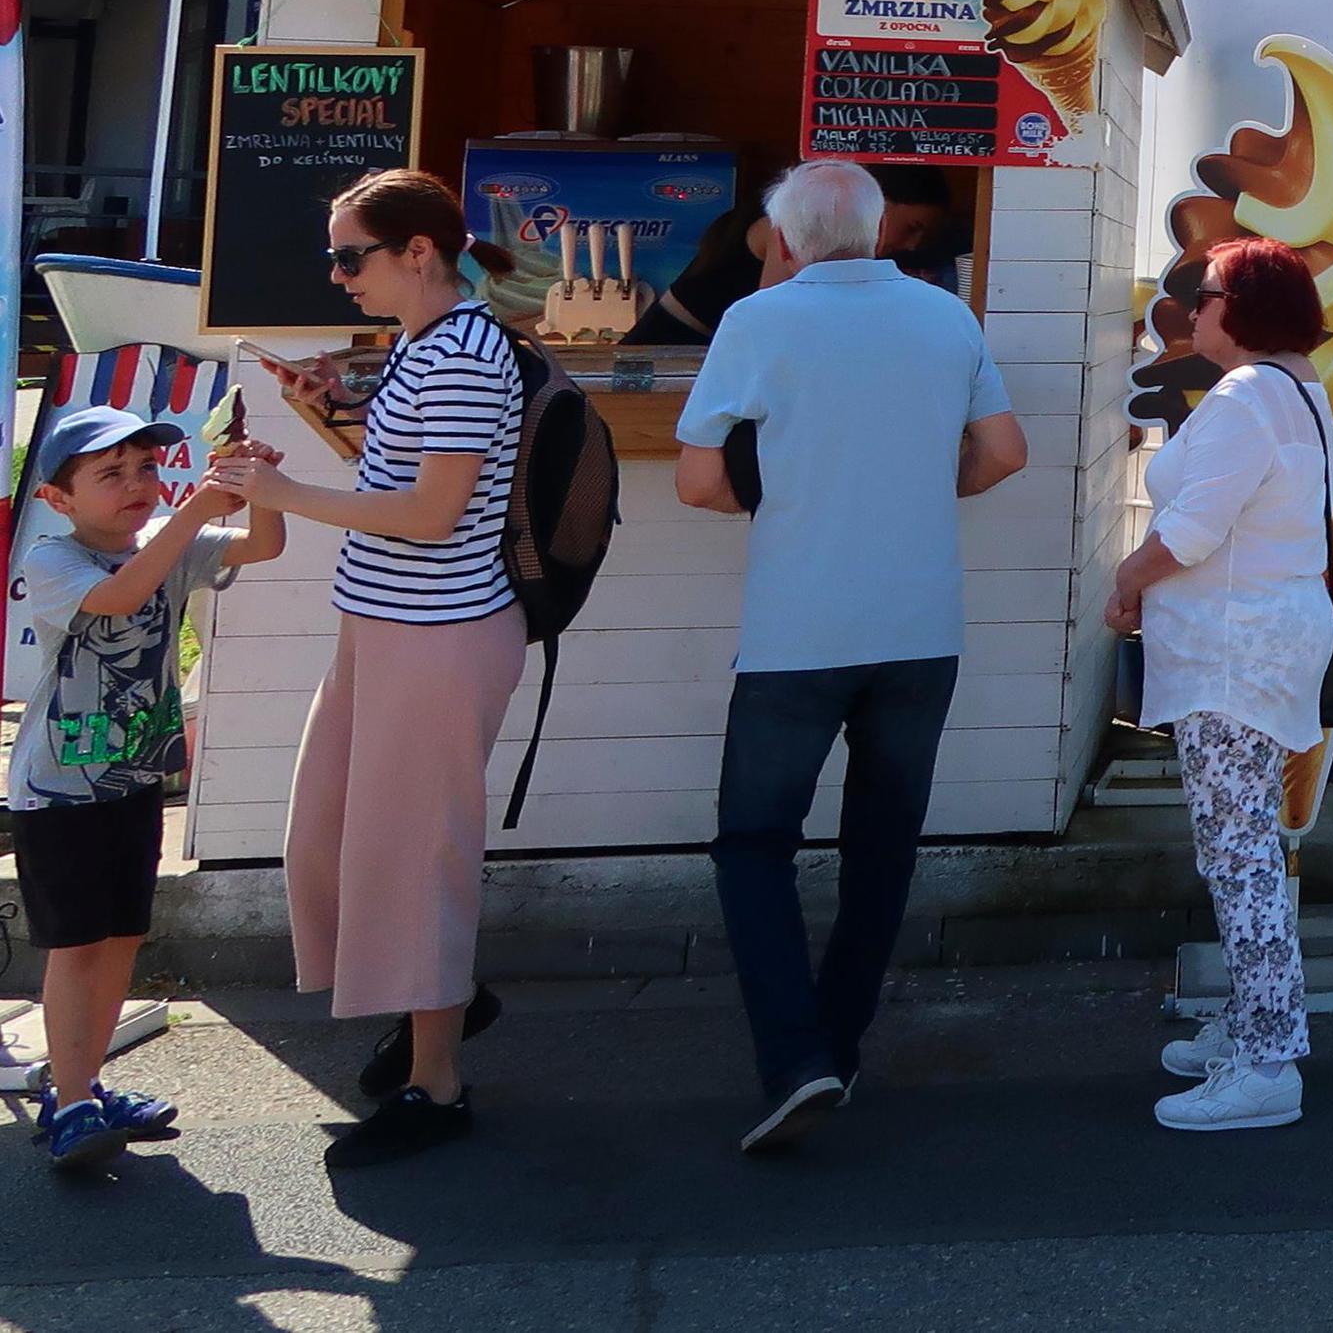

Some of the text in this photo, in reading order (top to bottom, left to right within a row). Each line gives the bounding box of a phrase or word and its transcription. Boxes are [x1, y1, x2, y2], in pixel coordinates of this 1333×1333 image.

[844, 0, 976, 21] ZMRZLINA
[879, 21, 889, 30] Z
[821, 50, 952, 77] VANILKA
[231, 60, 405, 95] LENTILKOVÝ
[819, 75, 962, 103] ČOKOLÁDA
[818, 104, 930, 129] MÍCHANÁ
[225, 133, 311, 150] ZMRZLINA
[329, 133, 406, 153] LENTILKY
[259, 149, 366, 168] DO KELÍMKU
